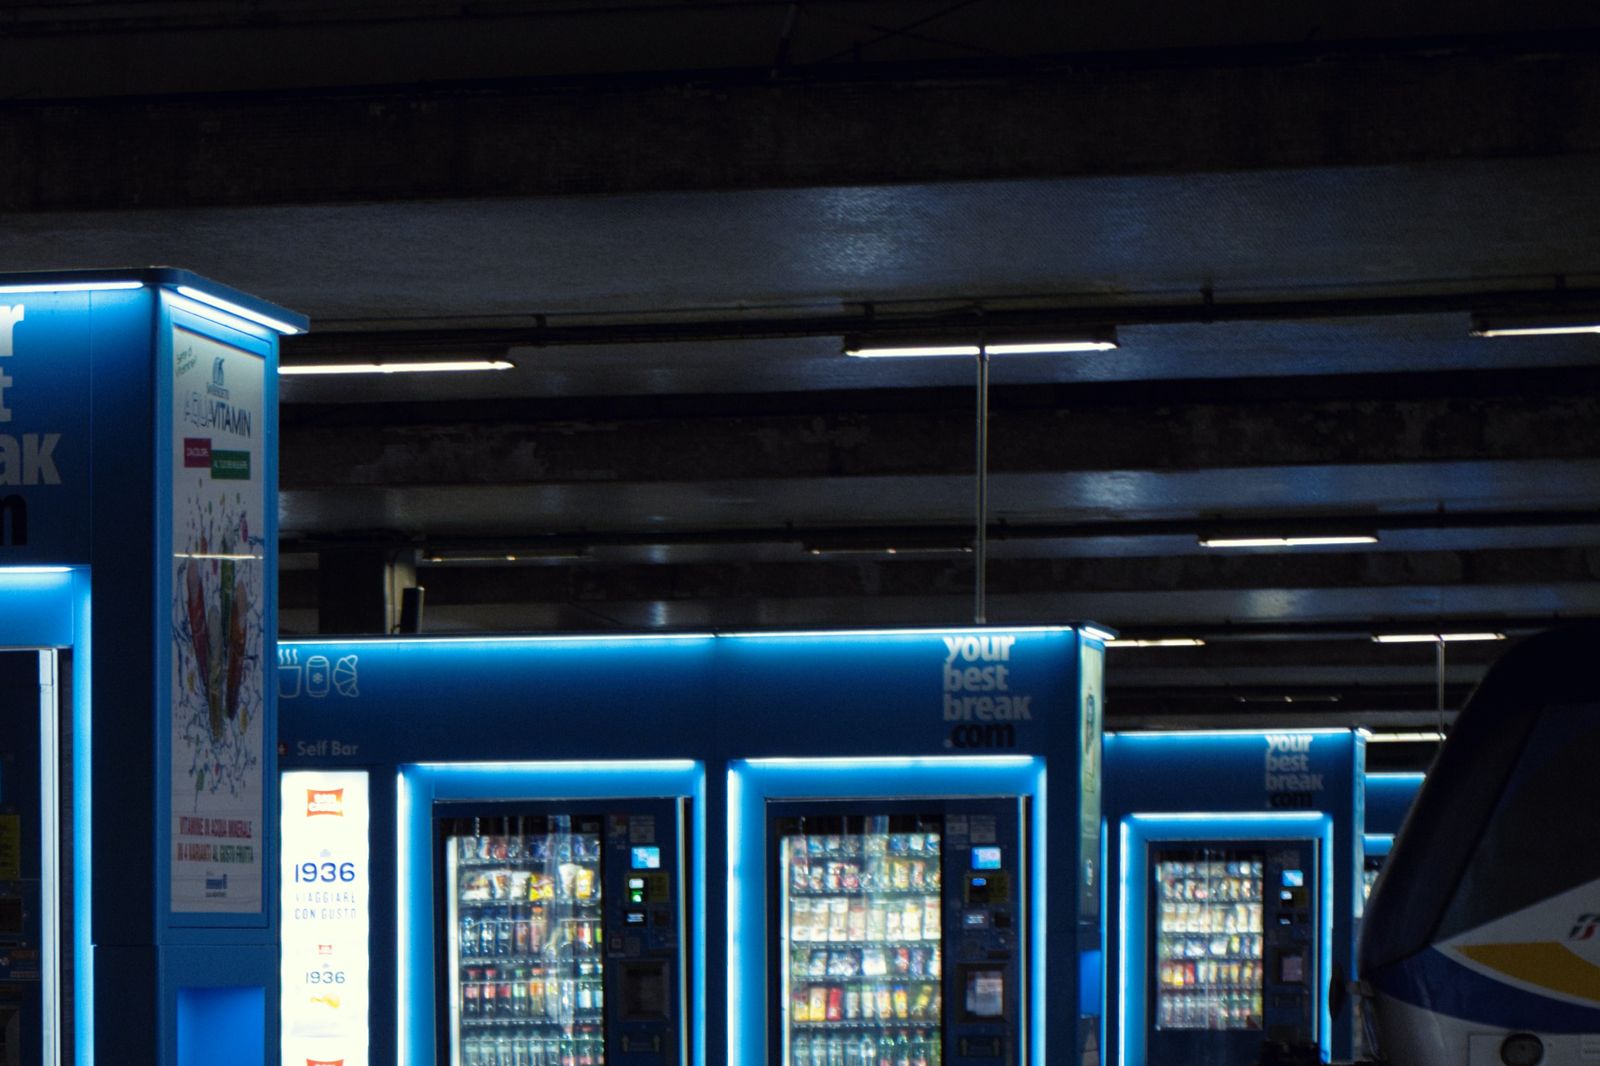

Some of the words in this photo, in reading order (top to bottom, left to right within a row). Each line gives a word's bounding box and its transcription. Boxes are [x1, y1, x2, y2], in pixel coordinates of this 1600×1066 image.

[942, 634, 1016, 664] your
[942, 663, 1010, 692] best
[942, 693, 1033, 721] break
[943, 723, 1016, 749] .com
[1264, 734, 1313, 752] your
[296, 740, 328, 757] Self
[332, 741, 360, 757] Bar
[1264, 749, 1310, 772] best
[1264, 772, 1326, 792] break
[294, 862, 357, 883] 1936
[294, 908, 317, 921] CON
[321, 908, 357, 920] GUSTO
[305, 971, 346, 985] 1936
